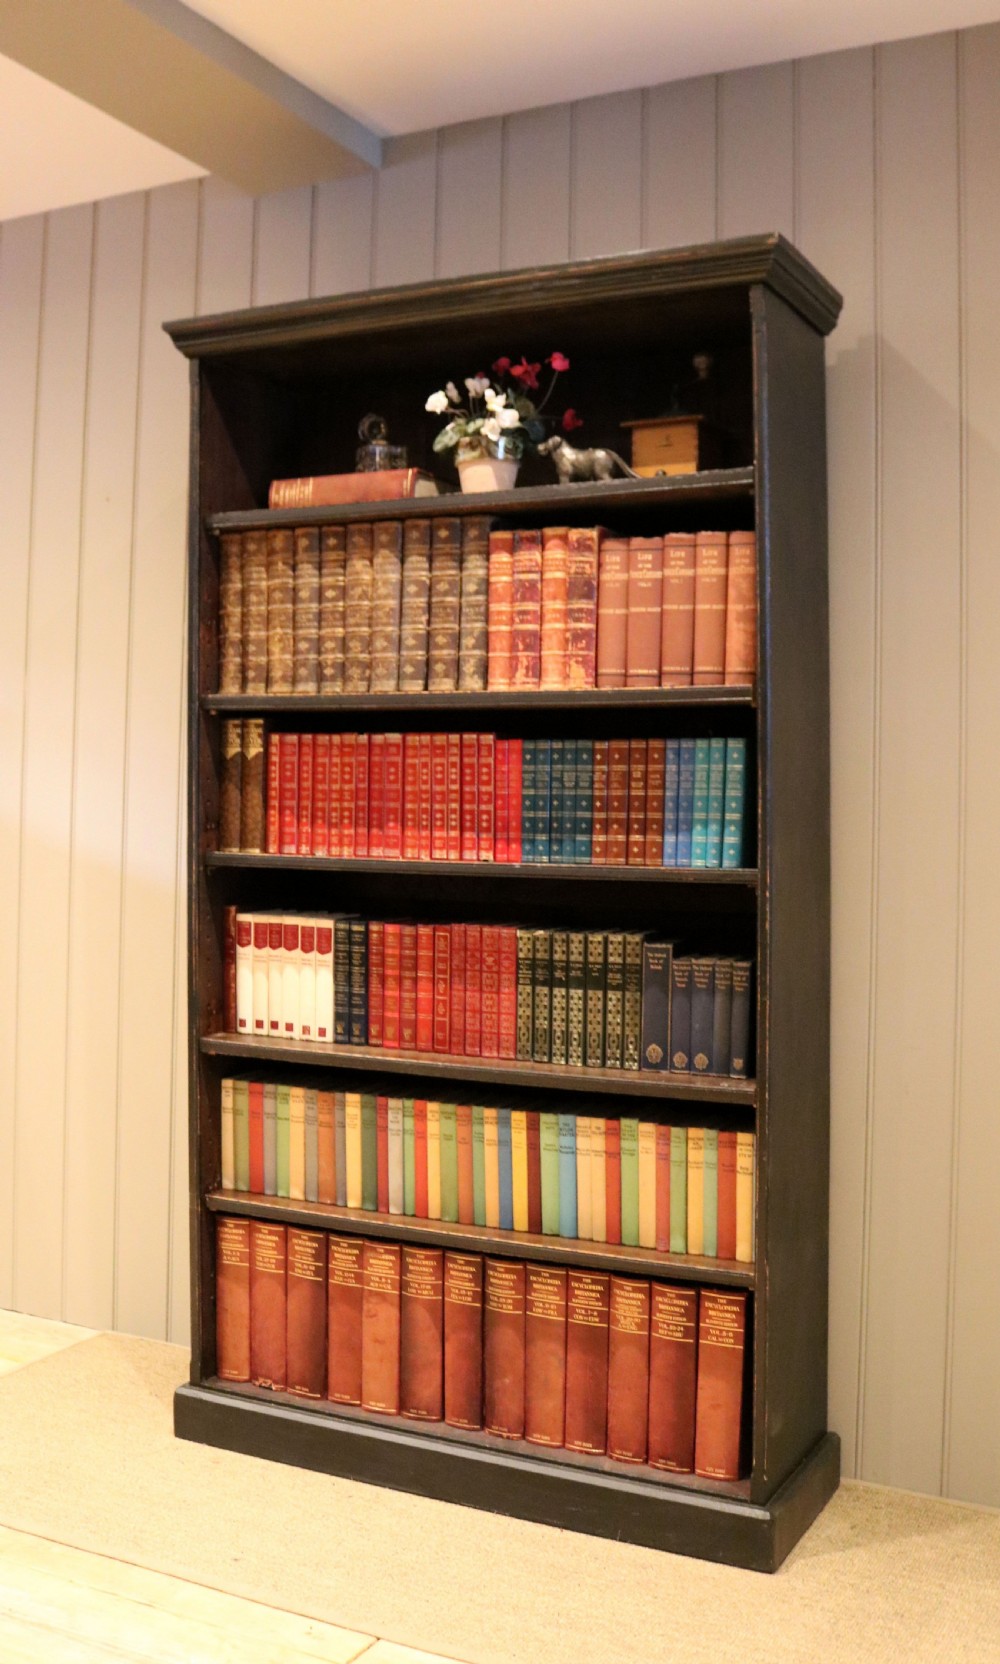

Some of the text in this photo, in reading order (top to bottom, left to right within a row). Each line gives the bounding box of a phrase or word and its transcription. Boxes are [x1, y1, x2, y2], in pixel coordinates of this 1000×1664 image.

[574, 1289, 601, 1299] BRITANNICA
[658, 1303, 685, 1314] BRITANNICA
[708, 1310, 736, 1320] BRITANNICA
